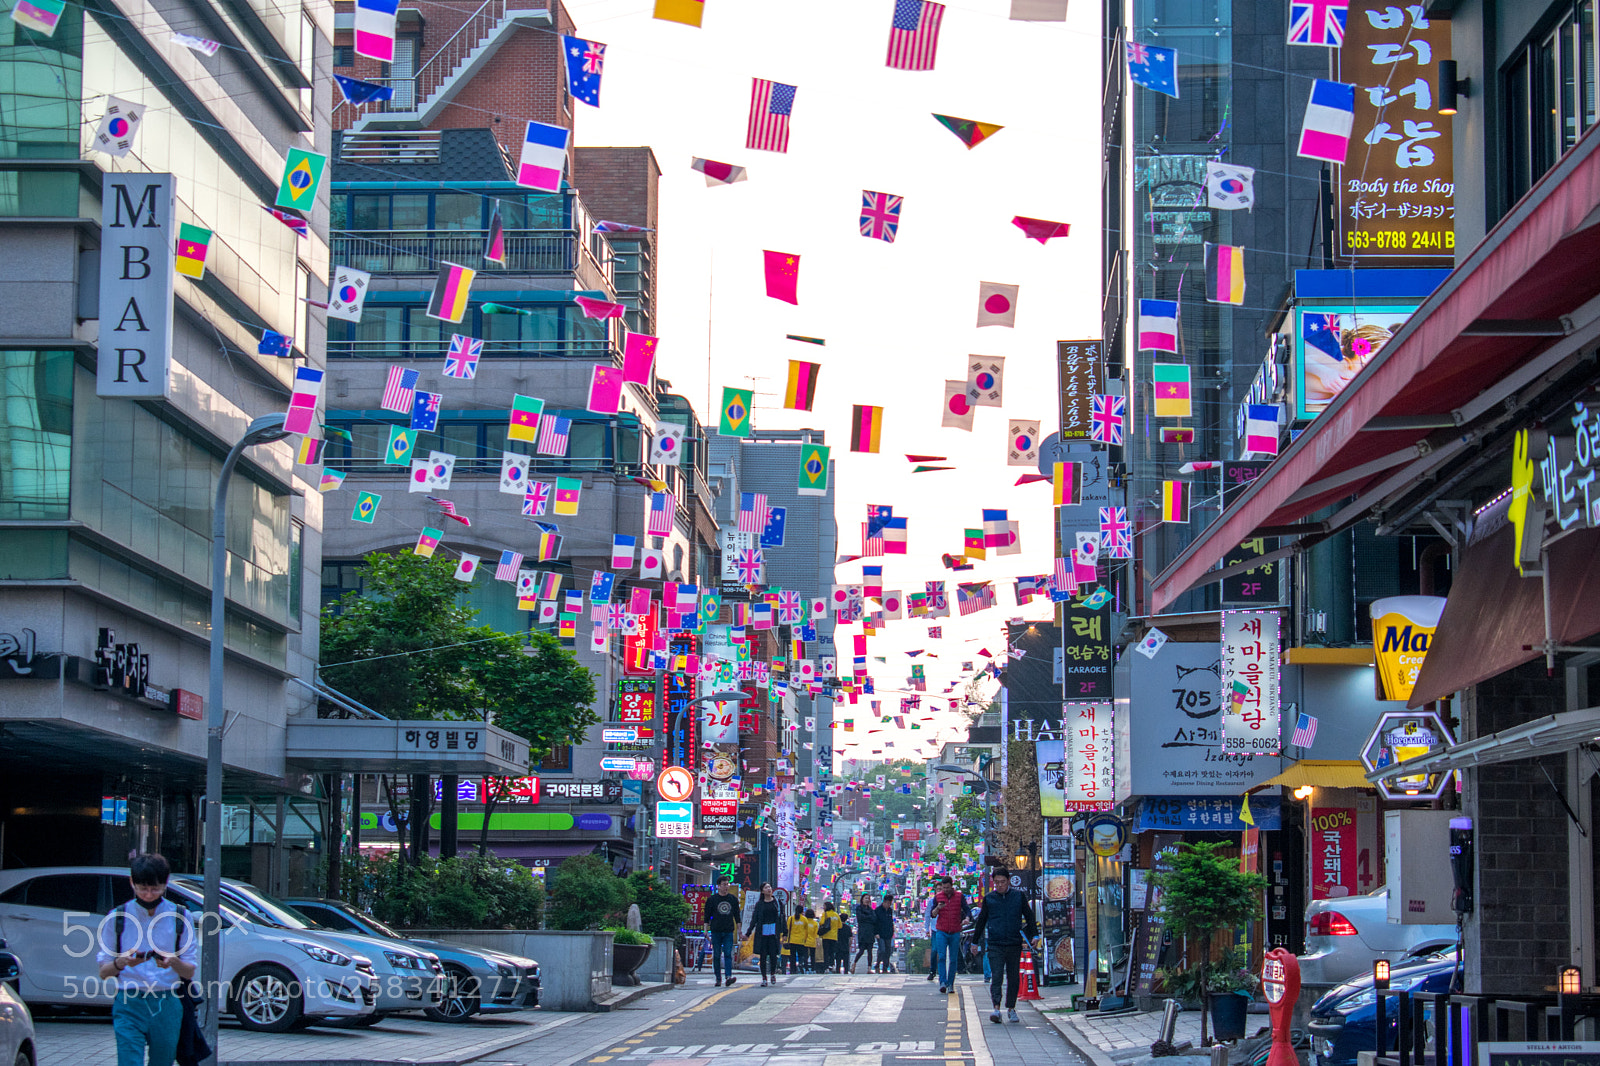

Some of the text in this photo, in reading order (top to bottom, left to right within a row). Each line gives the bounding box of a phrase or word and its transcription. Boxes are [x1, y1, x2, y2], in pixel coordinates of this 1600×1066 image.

[1348, 178, 1389, 198] Body
[1393, 178, 1417, 194] the
[1145, 212, 1178, 221] CRAFT
[1347, 230, 1406, 249] 563-8788
[1412, 230, 1441, 249] 24시
[1242, 583, 1262, 595] 2F
[1382, 625, 1435, 653] Ma
[1066, 644, 1110, 660] 연습장
[1399, 654, 1425, 664] Crea
[1068, 666, 1107, 674] KARAOKE
[1239, 618, 1266, 730] 새마을식당
[1079, 682, 1096, 693] 2F
[1172, 689, 1211, 709] 705
[405, 730, 478, 750] 하영빌딩
[1174, 727, 1221, 742] 사케
[1386, 733, 1437, 745] Hoegaarden
[1079, 701, 1100, 798] 새마을식당
[1226, 738, 1278, 749] 558-6062
[1162, 770, 1254, 779] 수제요리가 맛있는 이자카야
[546, 783, 621, 797] 구이전문점 2F
[1067, 801, 1078, 810] 24
[1079, 801, 1094, 810] hrs
[1149, 798, 1182, 815] 705
[1187, 812, 1233, 825] 무한리필
[1311, 810, 1352, 832] 100%
[660, 822, 690, 835] 일방통행
[1323, 830, 1342, 886] 국산돼지
[1273, 934, 1289, 945] B1
